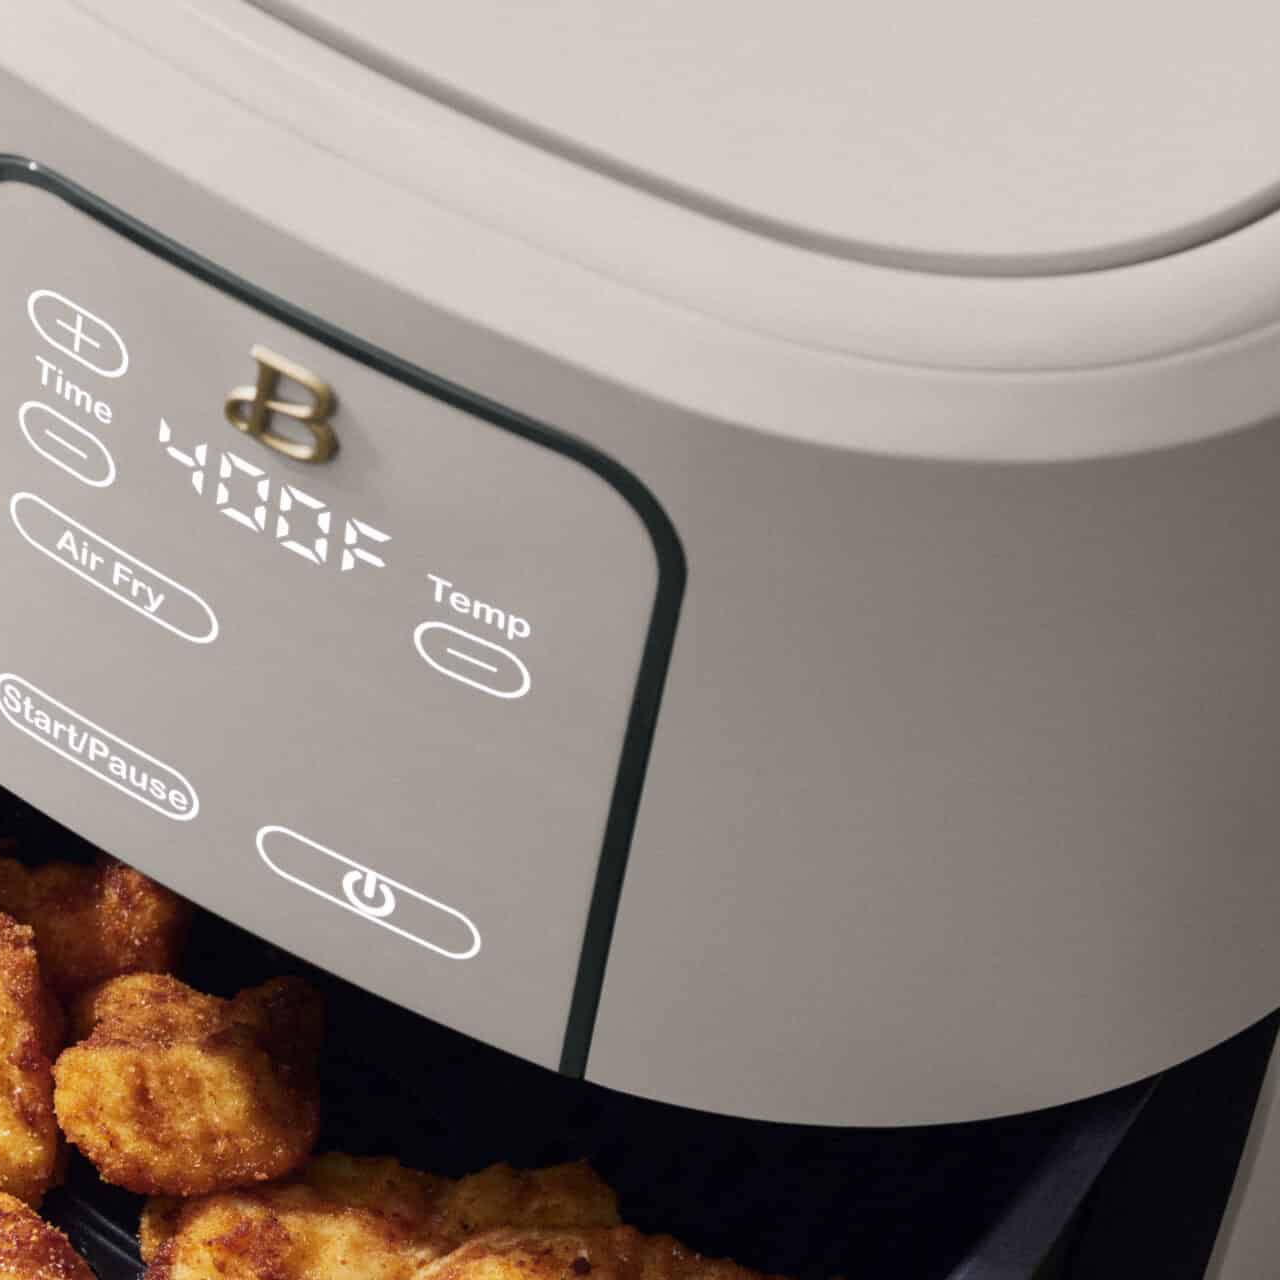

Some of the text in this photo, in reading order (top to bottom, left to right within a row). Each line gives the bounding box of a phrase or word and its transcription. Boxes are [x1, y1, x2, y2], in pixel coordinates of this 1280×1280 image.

[35, 355, 113, 424] Time
[159, 418, 392, 571] 400F
[56, 530, 165, 613] Air Fry
[427, 573, 531, 640] Temp
[2, 683, 188, 811] Start/Pause
